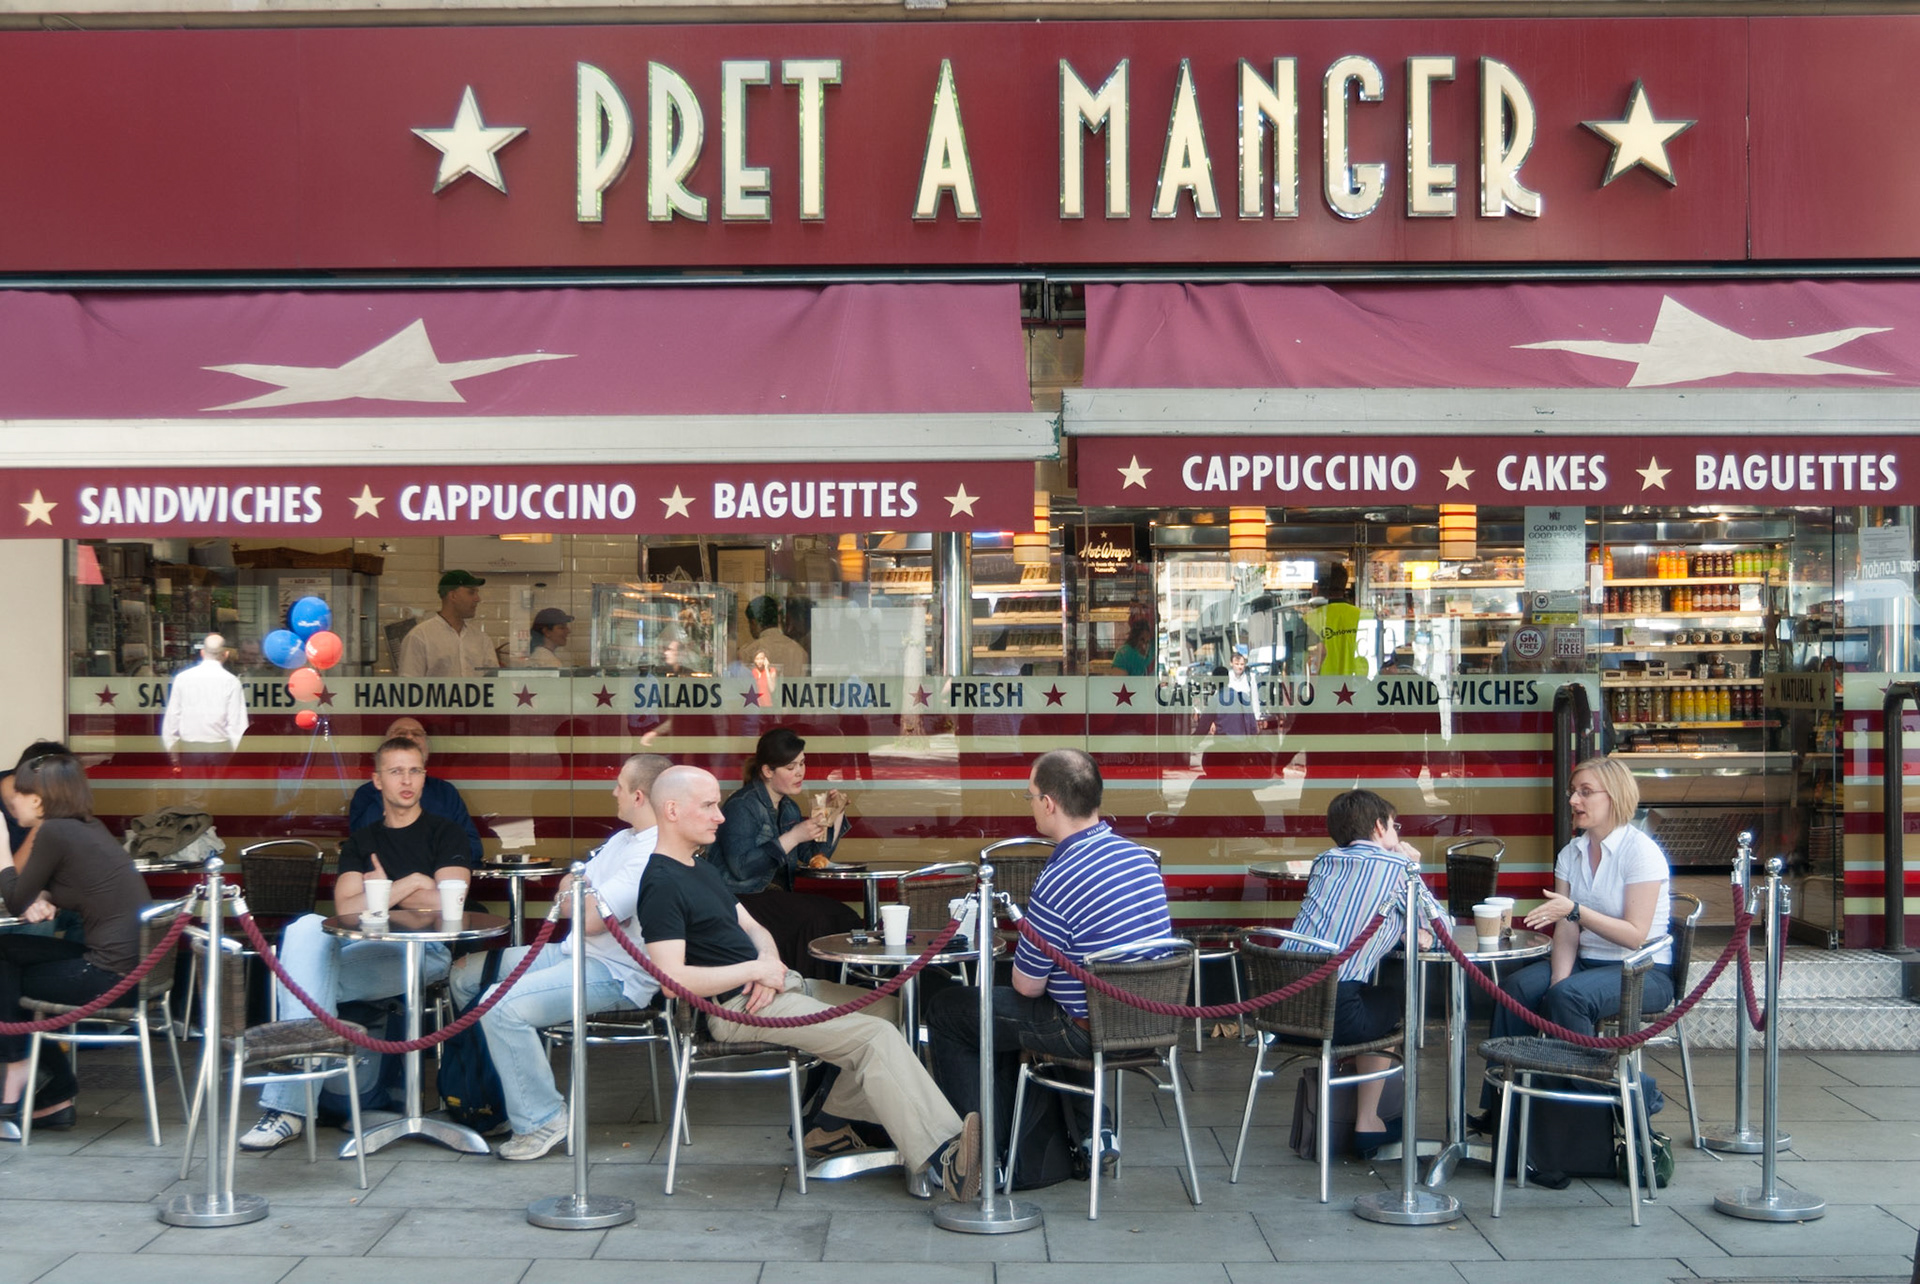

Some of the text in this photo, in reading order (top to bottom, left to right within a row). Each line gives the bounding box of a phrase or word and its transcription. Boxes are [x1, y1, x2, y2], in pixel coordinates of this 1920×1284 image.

[577, 55, 1542, 222] PRET A MANGER
[1182, 455, 1417, 492] CAPPUCCINO
[1497, 455, 1607, 491] CAKES
[1695, 454, 1897, 491] BAGUETTES
[80, 486, 323, 525] SANDWICHES
[399, 483, 636, 521] CAPPUCCINO
[714, 481, 918, 519] BAGUETTES
[1528, 532, 1553, 540] GOOD
[1533, 524, 1577, 532] GOOD JOBS
[1079, 542, 1131, 561] Hot Wraps
[1520, 633, 1538, 643] GM
[1558, 643, 1580, 654] FREE
[355, 683, 494, 708] HANDMADE
[633, 683, 722, 708] SALADS
[781, 683, 891, 708] NATURAL
[950, 683, 1023, 708] FRESH
[1781, 678, 1813, 703] NATURAL
